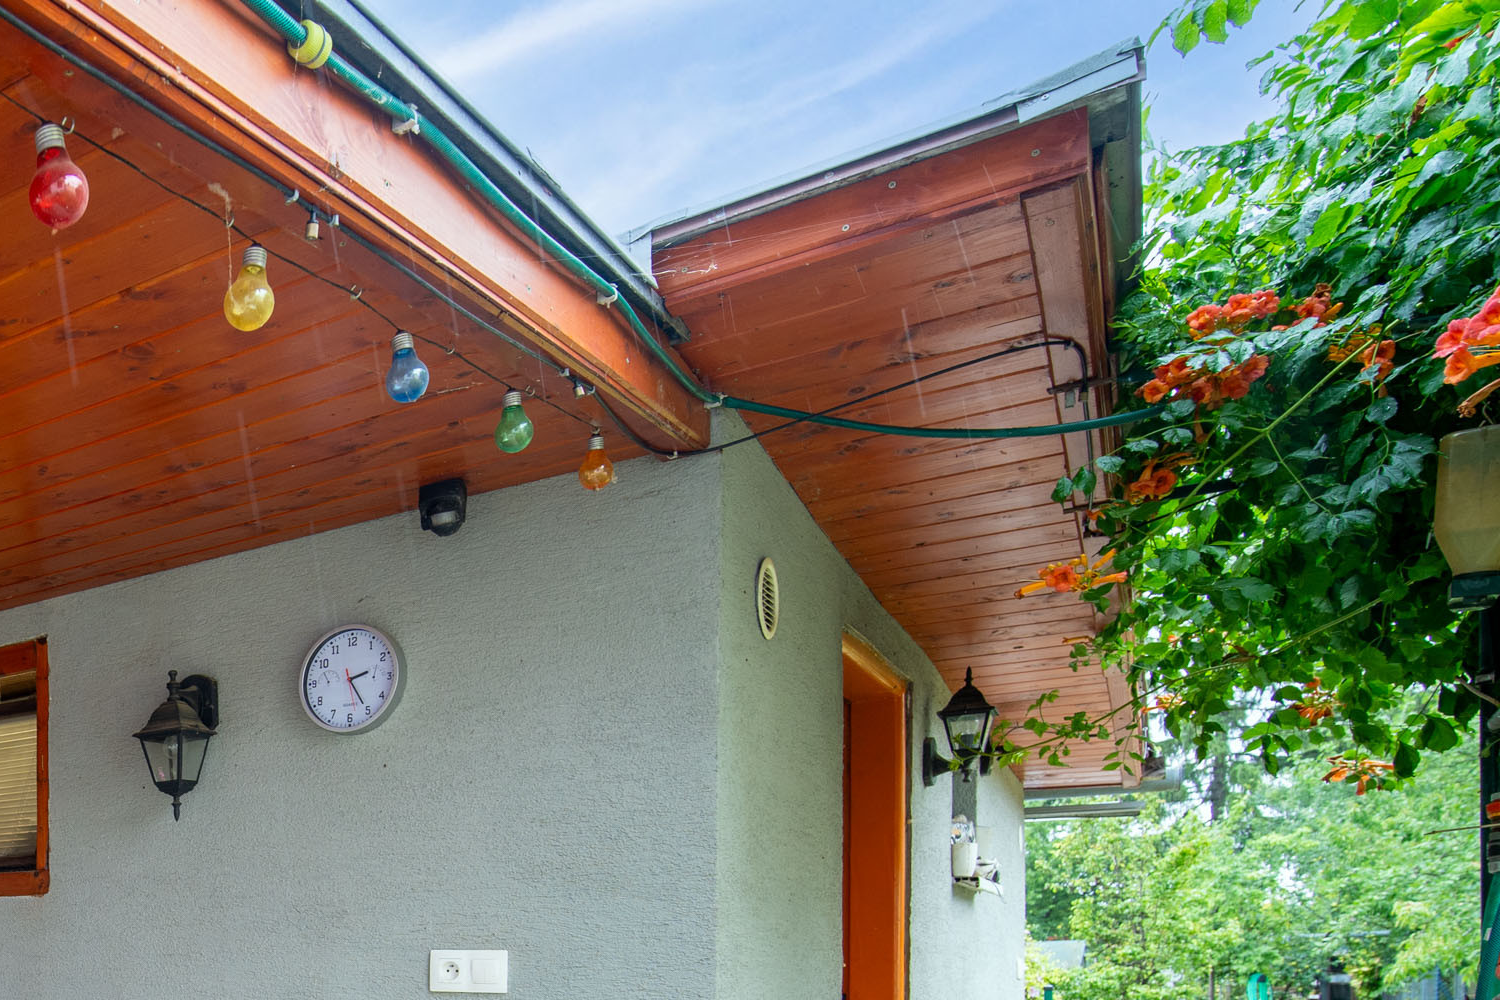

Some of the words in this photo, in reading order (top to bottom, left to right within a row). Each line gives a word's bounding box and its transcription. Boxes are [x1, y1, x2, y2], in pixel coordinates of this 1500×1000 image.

[348, 636, 358, 647] 12
[369, 641, 373, 650] 1
[332, 645, 340, 654] 11
[380, 652, 386, 662] 2
[319, 658, 328, 668] 10
[387, 672, 392, 680] 3
[312, 680, 317, 688] 9
[379, 691, 384, 700] 4
[318, 696, 322, 706] 8
[331, 710, 336, 719] 7
[366, 706, 370, 715] 5
[348, 714, 352, 722] 6
